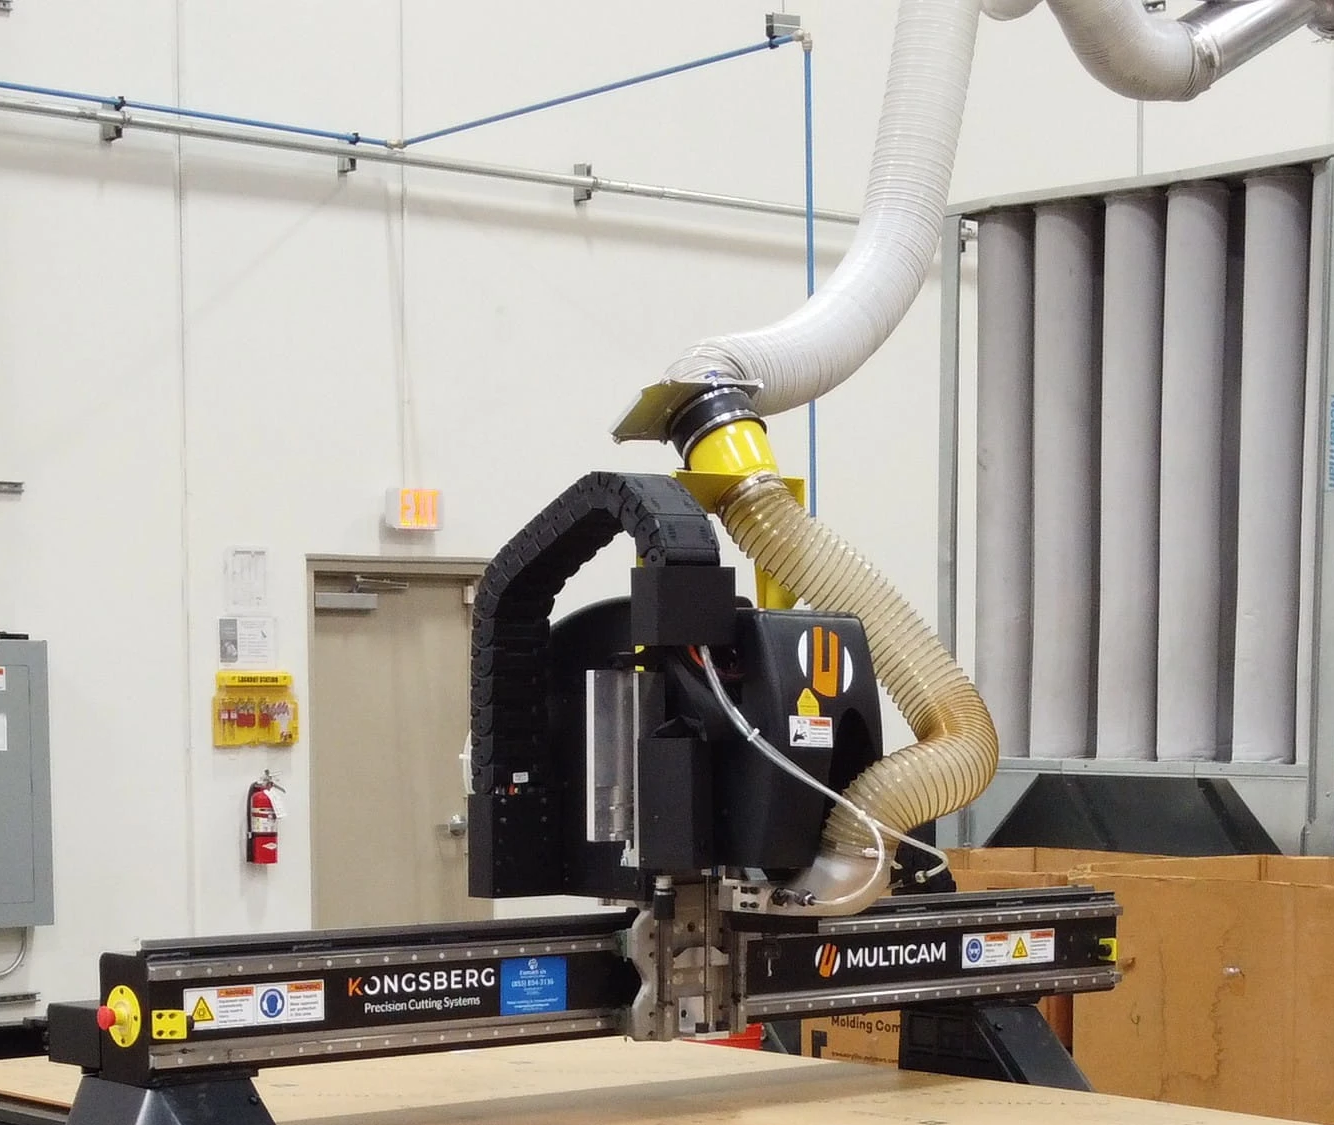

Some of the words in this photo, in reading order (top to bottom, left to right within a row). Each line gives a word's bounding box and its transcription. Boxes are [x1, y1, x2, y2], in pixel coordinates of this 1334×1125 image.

[400, 489, 439, 526] EXIT
[259, 675, 279, 683] STATION
[847, 942, 946, 969] MULTICAM
[347, 967, 496, 997] KONGSBERG
[364, 1001, 407, 1014] Precision
[408, 998, 443, 1010] Cutting
[444, 996, 481, 1008] Systems
[831, 1016, 873, 1034] Molding
